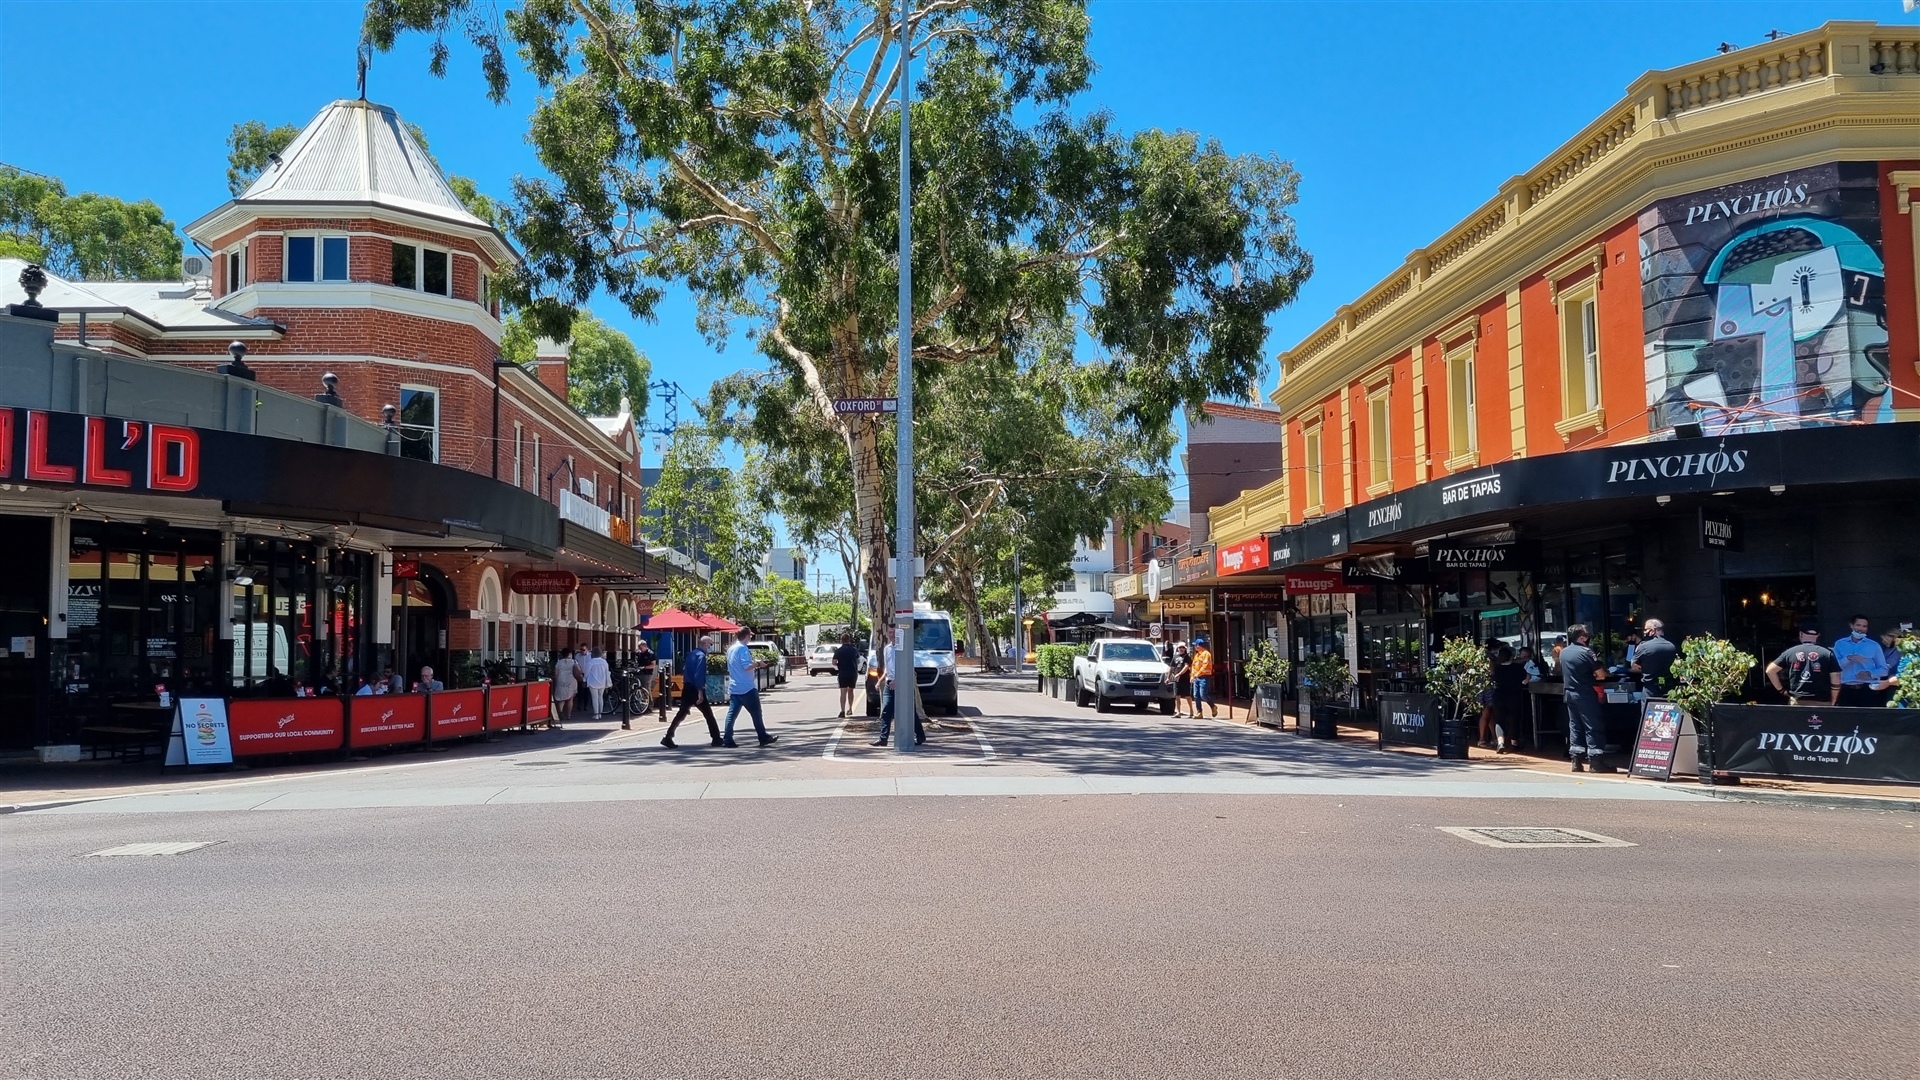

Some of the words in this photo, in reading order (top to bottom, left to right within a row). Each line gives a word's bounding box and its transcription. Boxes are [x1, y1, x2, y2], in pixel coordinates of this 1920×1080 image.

[1684, 183, 1808, 226] PINCHOS
[840, 401, 876, 411] OXFORD
[1607, 449, 1749, 483] PINCHOS
[1442, 489, 1457, 504] BAR
[1458, 486, 1469, 500] DE
[1470, 480, 1501, 497] TAPAS
[1368, 503, 1402, 527] PINCHOS
[1704, 520, 1732, 539] PINCHOS
[1436, 549, 1506, 562] PINCHOS
[1288, 578, 1334, 590] Thuggs
[1392, 712, 1425, 727] PINCHOS
[239, 732, 273, 740] SUPPORTING
[1757, 732, 1878, 755] PINCHOS
[1818, 755, 1838, 763] Tapas
